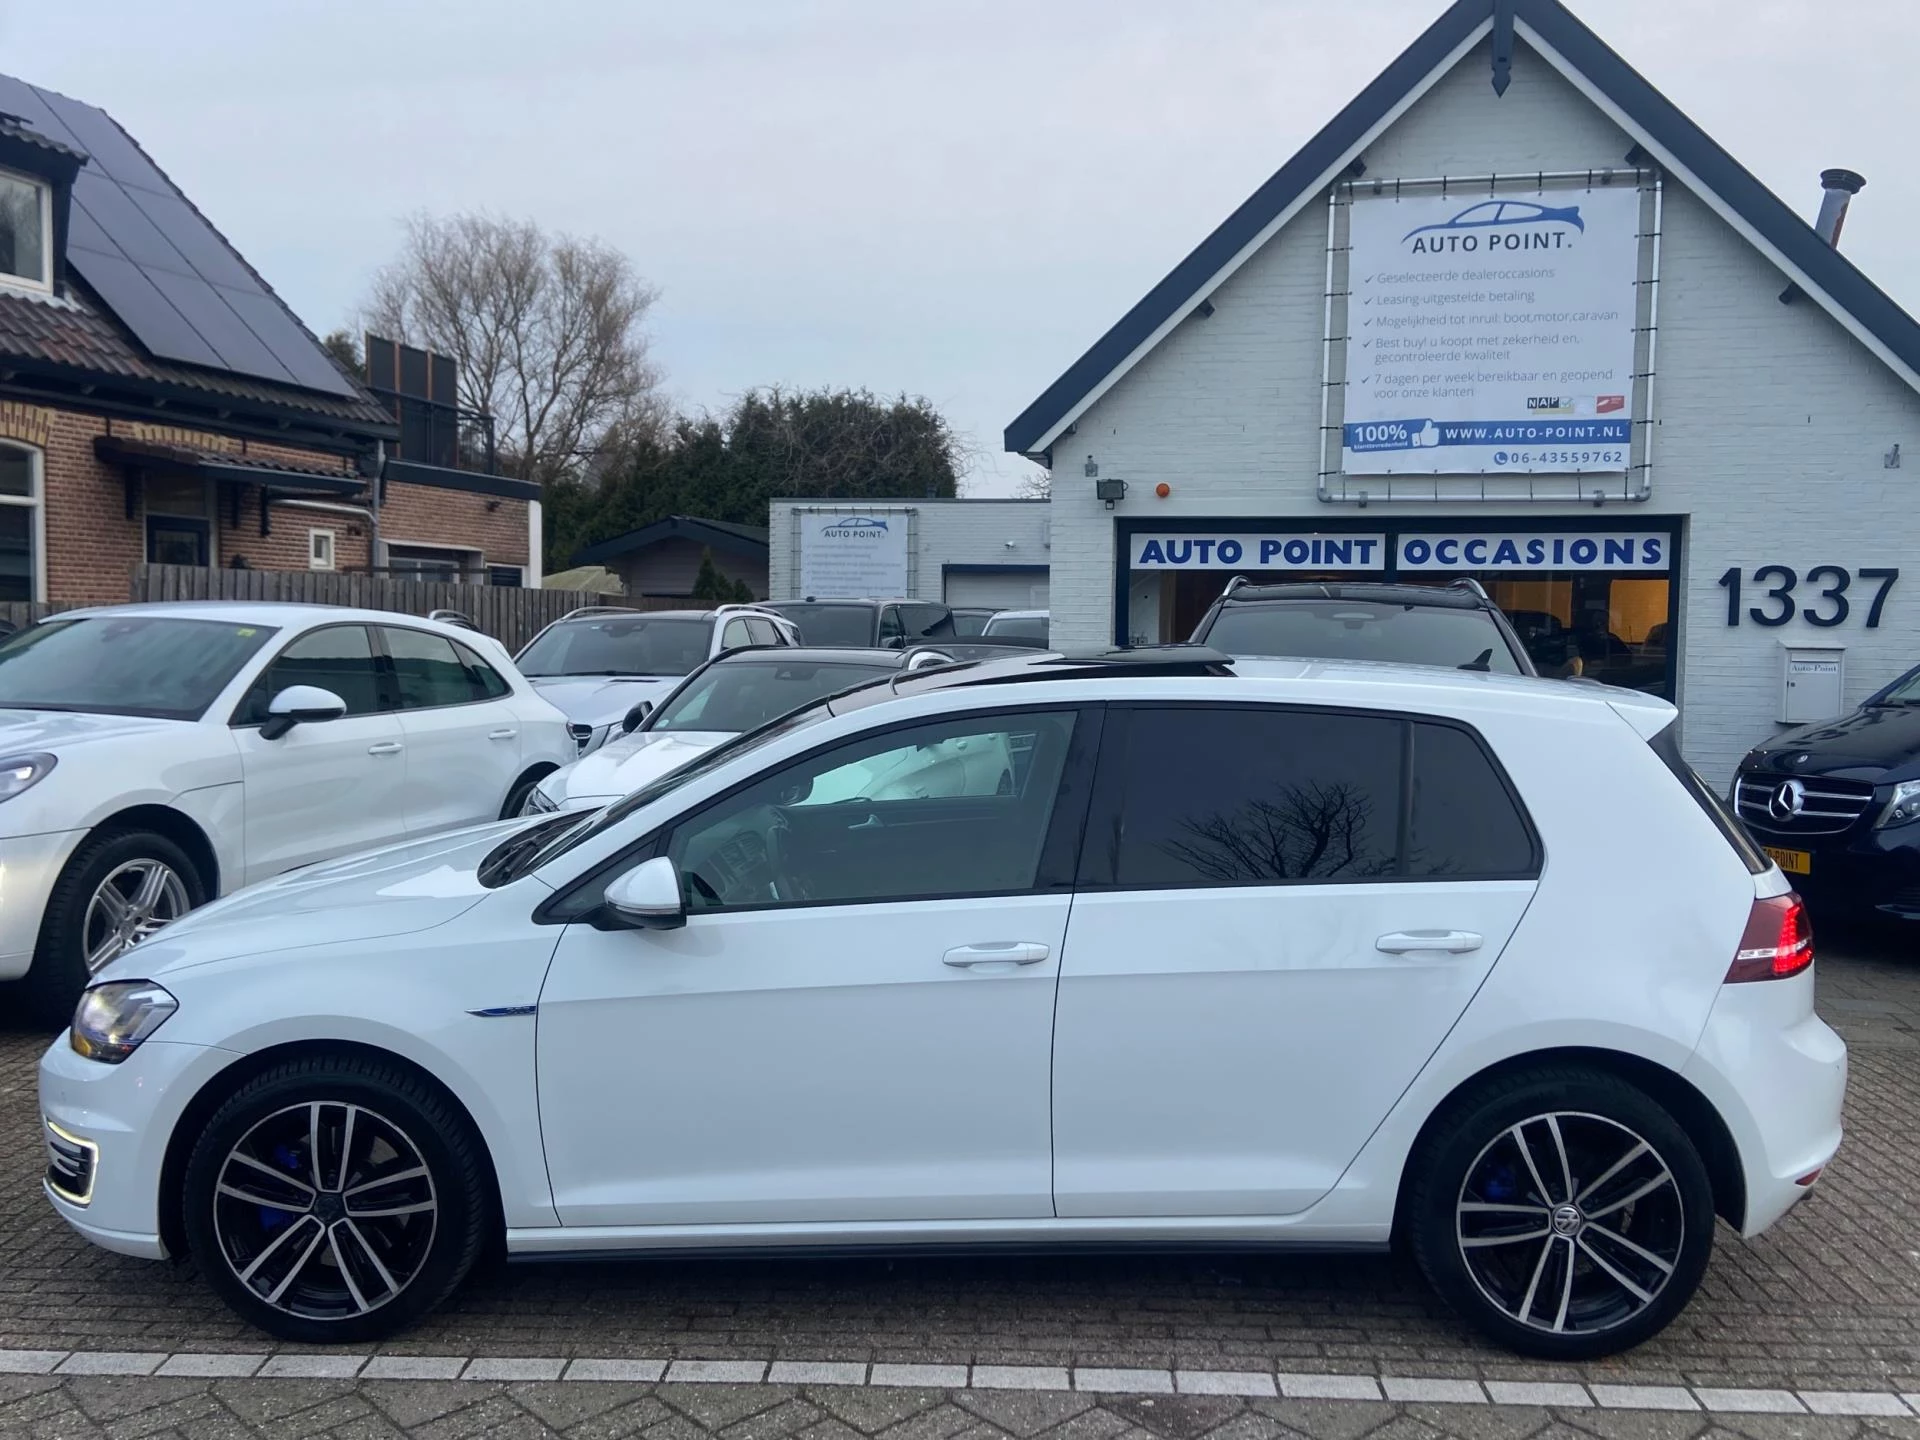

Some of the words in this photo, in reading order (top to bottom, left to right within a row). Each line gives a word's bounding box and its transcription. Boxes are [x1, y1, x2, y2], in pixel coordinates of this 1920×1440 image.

[1411, 235, 1478, 254] AUTO
[1377, 268, 1459, 284] Geselecteerde
[1462, 267, 1556, 281] dealeroccasions
[1489, 289, 1535, 304] betaling
[1376, 313, 1447, 329] Mogelijkheid
[1450, 314, 1466, 325] tot
[1375, 337, 1400, 349] Best
[1430, 339, 1438, 347] u
[1441, 336, 1474, 348] koopt
[1477, 336, 1499, 346] met
[1502, 333, 1559, 346] zekerheid
[1374, 351, 1460, 366] gecontroleerde
[1464, 350, 1510, 361] kwaliteit
[1375, 373, 1382, 384] 7
[1384, 374, 1419, 386] dagen
[1422, 374, 1442, 385] per
[1445, 371, 1475, 383] week
[1477, 370, 1539, 382] bereikbaar
[1542, 372, 1557, 381] en
[1560, 369, 1613, 384] geopend
[1374, 389, 1399, 399] voor
[1401, 388, 1429, 398] onze
[1432, 387, 1474, 398] klanten
[1527, 396, 1560, 409] NAP
[1355, 424, 1408, 442] 100%
[1445, 425, 1623, 439] WWW.AUTO-POINT.NL
[1511, 451, 1622, 463] 06-43559762
[824, 530, 850, 538] AUTO
[1139, 539, 1243, 564] AUTO
[1260, 539, 1377, 564] POINT
[1404, 538, 1662, 565] OCCASIONS
[1718, 565, 1899, 628] 1337
